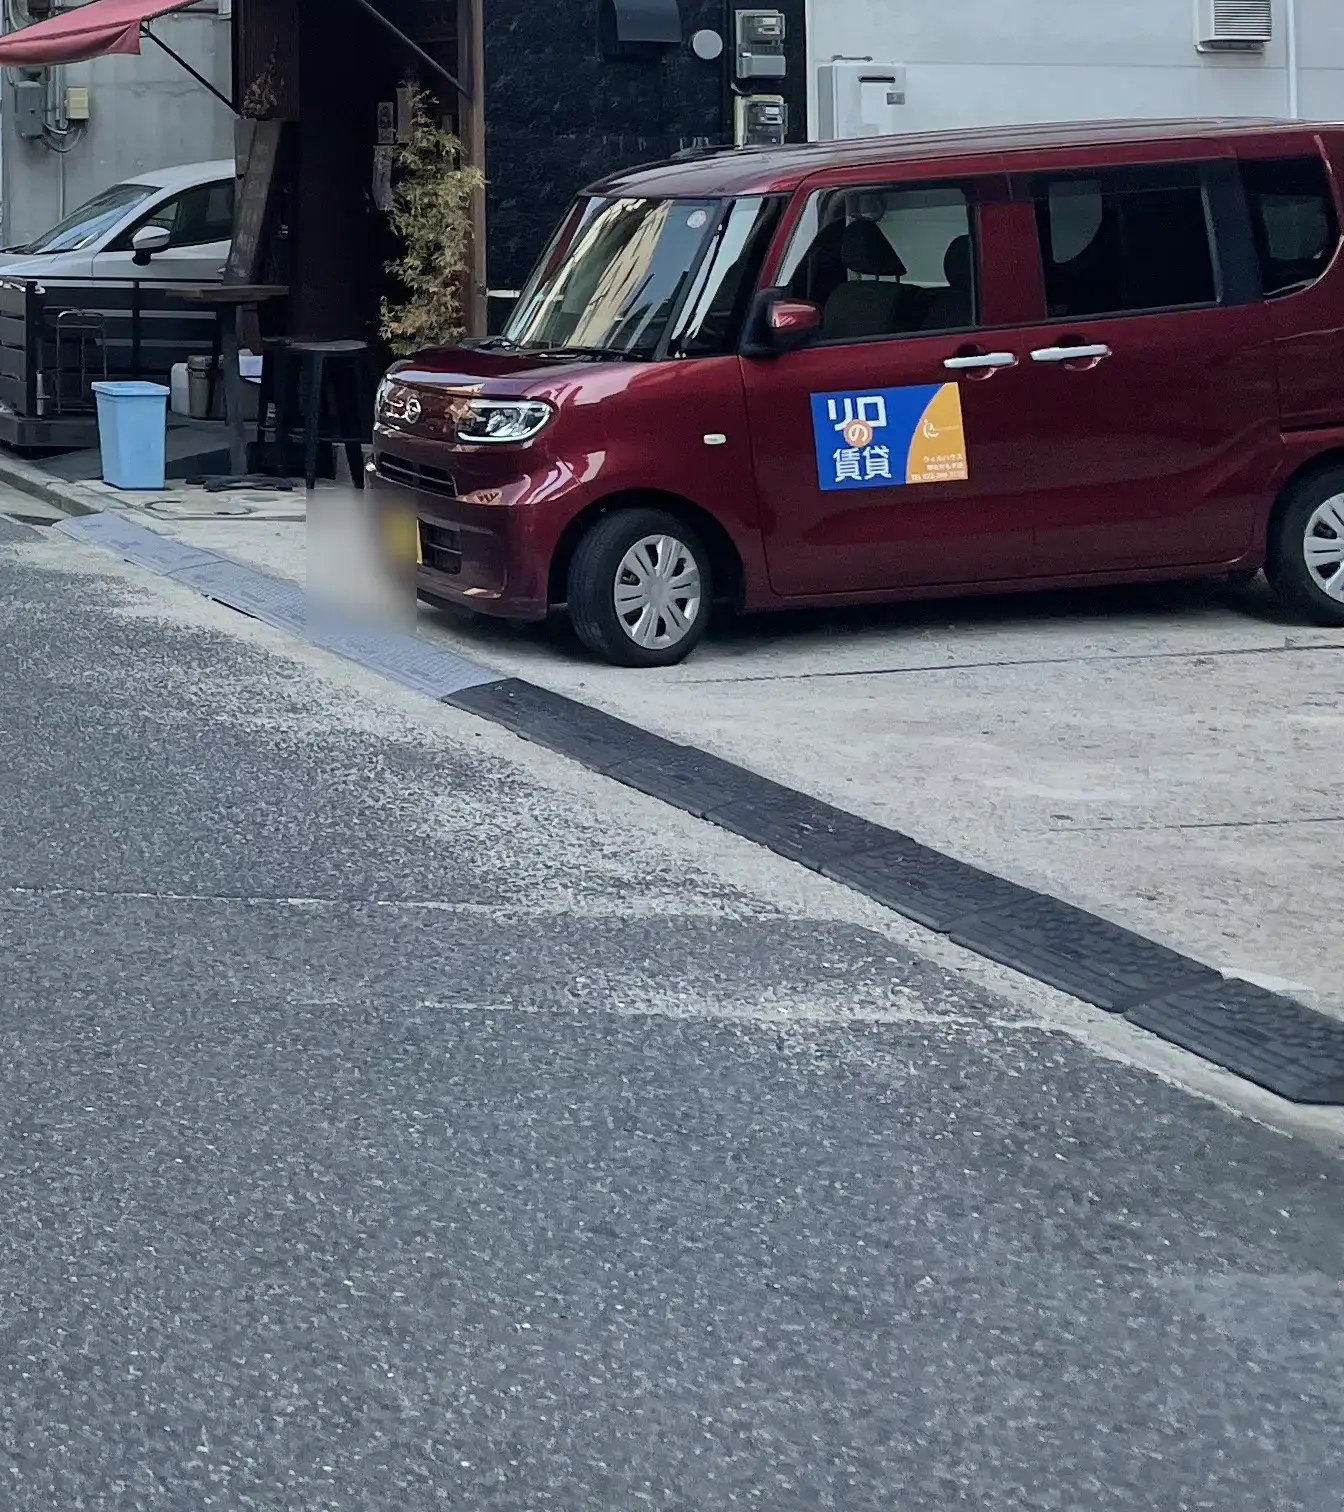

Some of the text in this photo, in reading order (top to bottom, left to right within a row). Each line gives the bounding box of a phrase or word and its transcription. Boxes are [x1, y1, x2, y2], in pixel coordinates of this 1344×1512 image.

[827, 395, 888, 432] リロ
[847, 423, 869, 442] の
[832, 444, 892, 483] 賃貸
